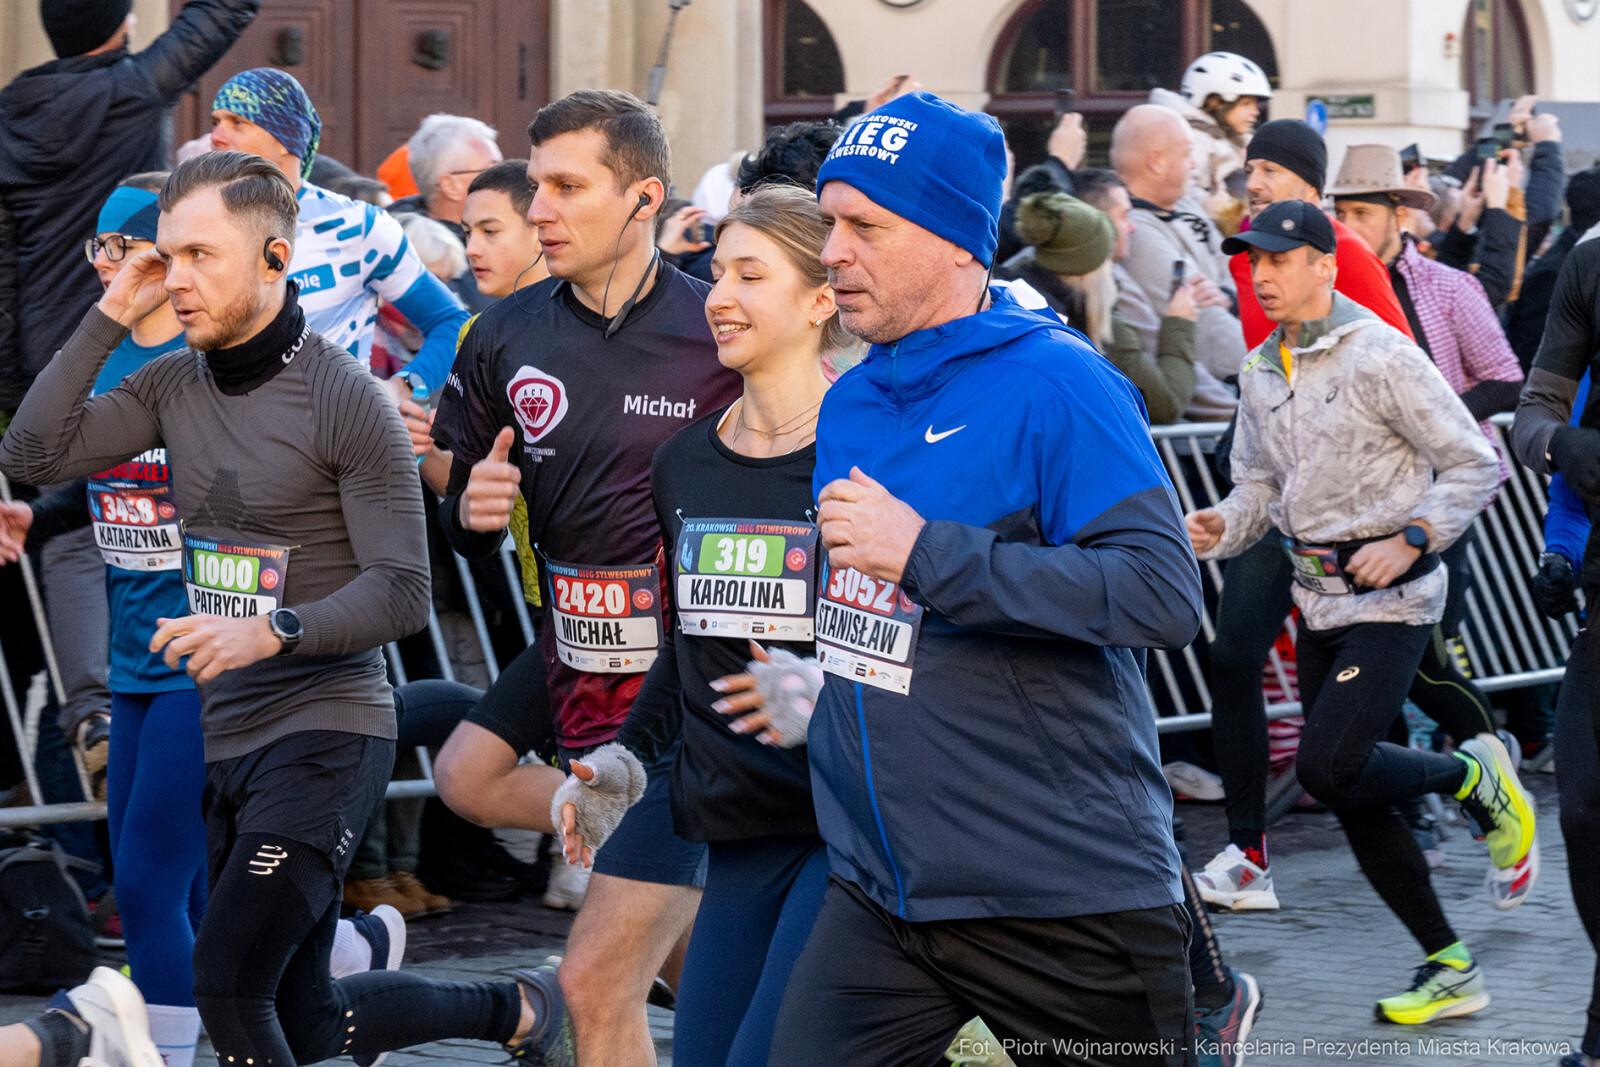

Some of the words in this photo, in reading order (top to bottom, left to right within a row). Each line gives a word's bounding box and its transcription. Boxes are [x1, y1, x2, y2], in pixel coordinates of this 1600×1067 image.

[623, 394, 697, 419] Michał
[131, 447, 166, 465] NA
[103, 494, 156, 524] 3458
[98, 525, 173, 548] KATARZYNA
[695, 523, 737, 533] KRAKOWSKI
[737, 524, 754, 533] BIEG
[755, 524, 813, 536] SYLWESTROWY
[217, 543, 232, 554] BIEG
[232, 545, 284, 559] SYLWESTROWY
[714, 537, 768, 573] 319
[197, 553, 253, 590] 1000
[578, 569, 595, 578] BIEG
[595, 568, 653, 580] SYLWESTROWY
[556, 578, 626, 615] 2420
[690, 578, 786, 609] KAROLINA
[829, 567, 896, 613] 3052
[561, 616, 627, 646] MICHAŁ
[817, 602, 901, 655] STANISŁAW
